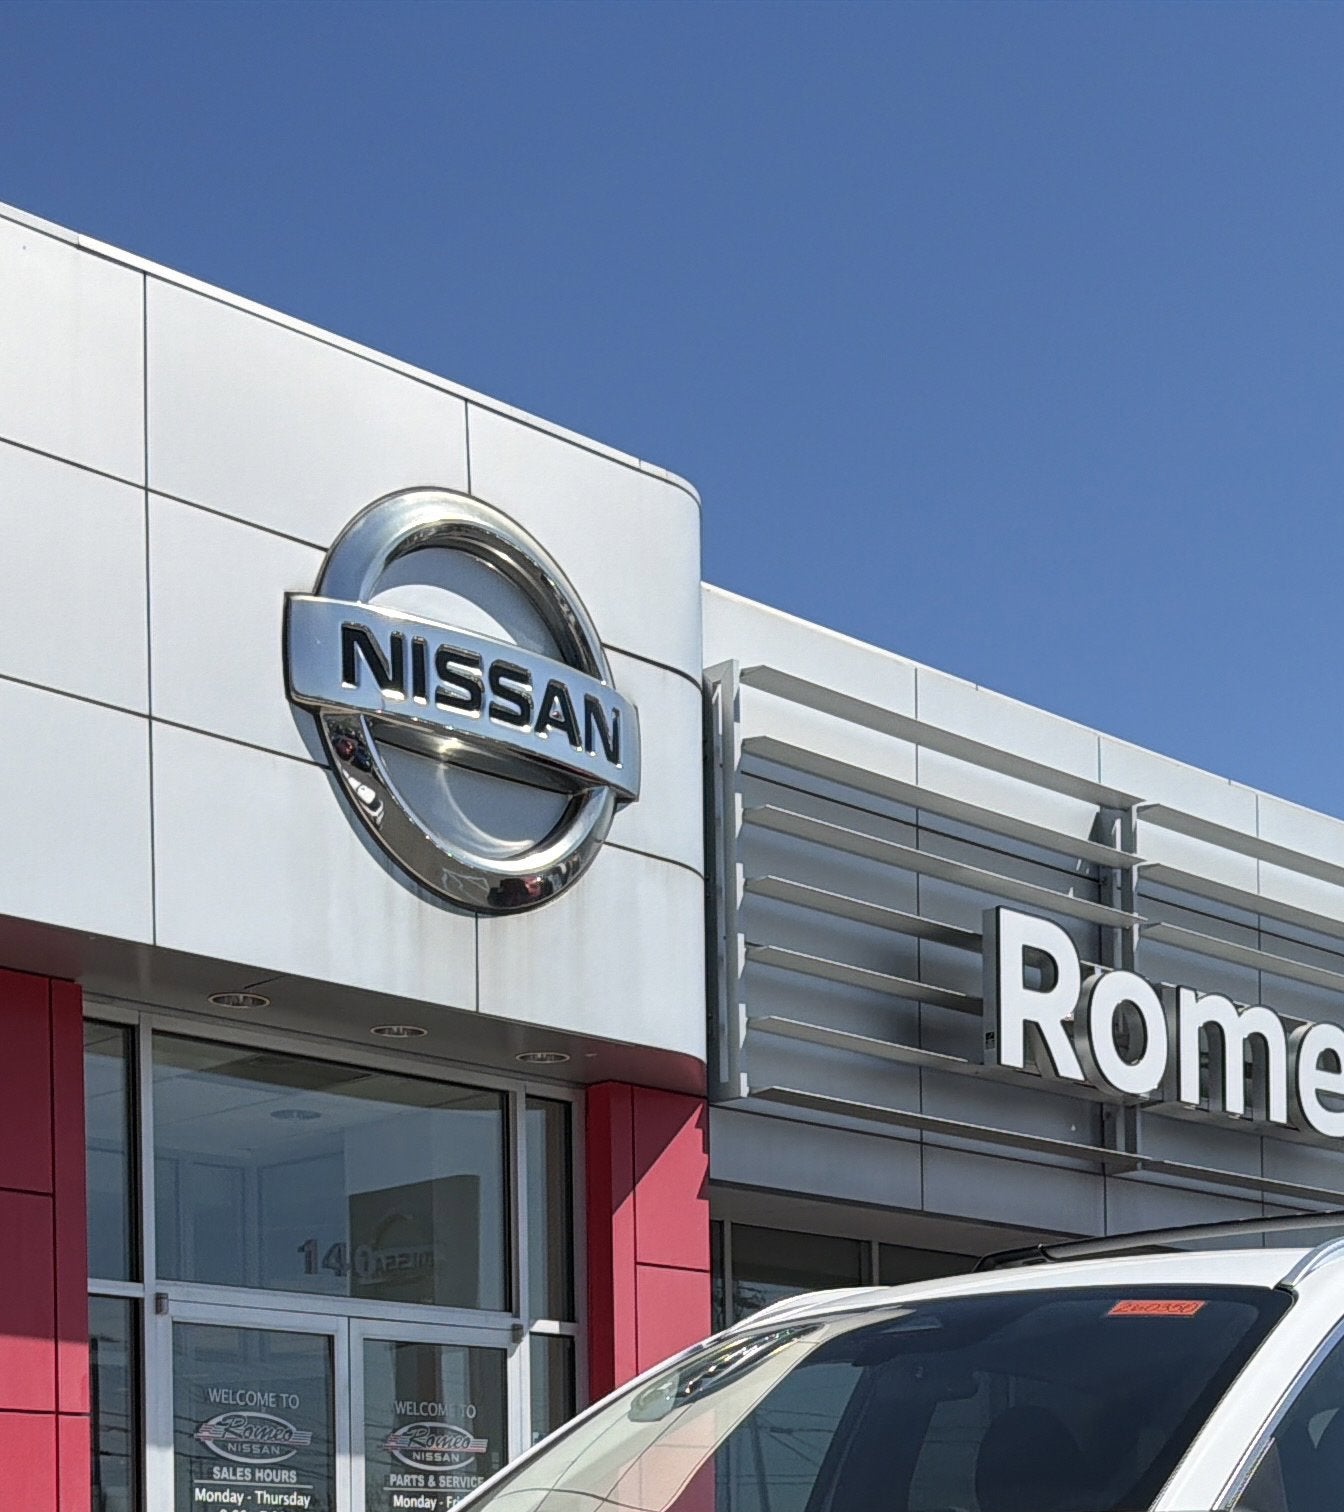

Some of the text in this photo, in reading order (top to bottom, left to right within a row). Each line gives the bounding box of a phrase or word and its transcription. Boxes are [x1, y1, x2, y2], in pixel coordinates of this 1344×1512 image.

[340, 620, 625, 769] NISSAN
[208, 1388, 300, 1409] WELCOME TO
[394, 1401, 459, 1418] WELCOM
[216, 1414, 294, 1442] Romeo
[406, 1425, 471, 1449] Romeo
[227, 1443, 281, 1455] NISSAN
[412, 1451, 460, 1463] NISSAN
[212, 1466, 297, 1483] SALES HOURS
[389, 1474, 485, 1489] PARTS & SERVICE
[194, 1487, 244, 1506] Monday
[254, 1490, 311, 1509] Thursday
[393, 1494, 437, 1510] Monday
